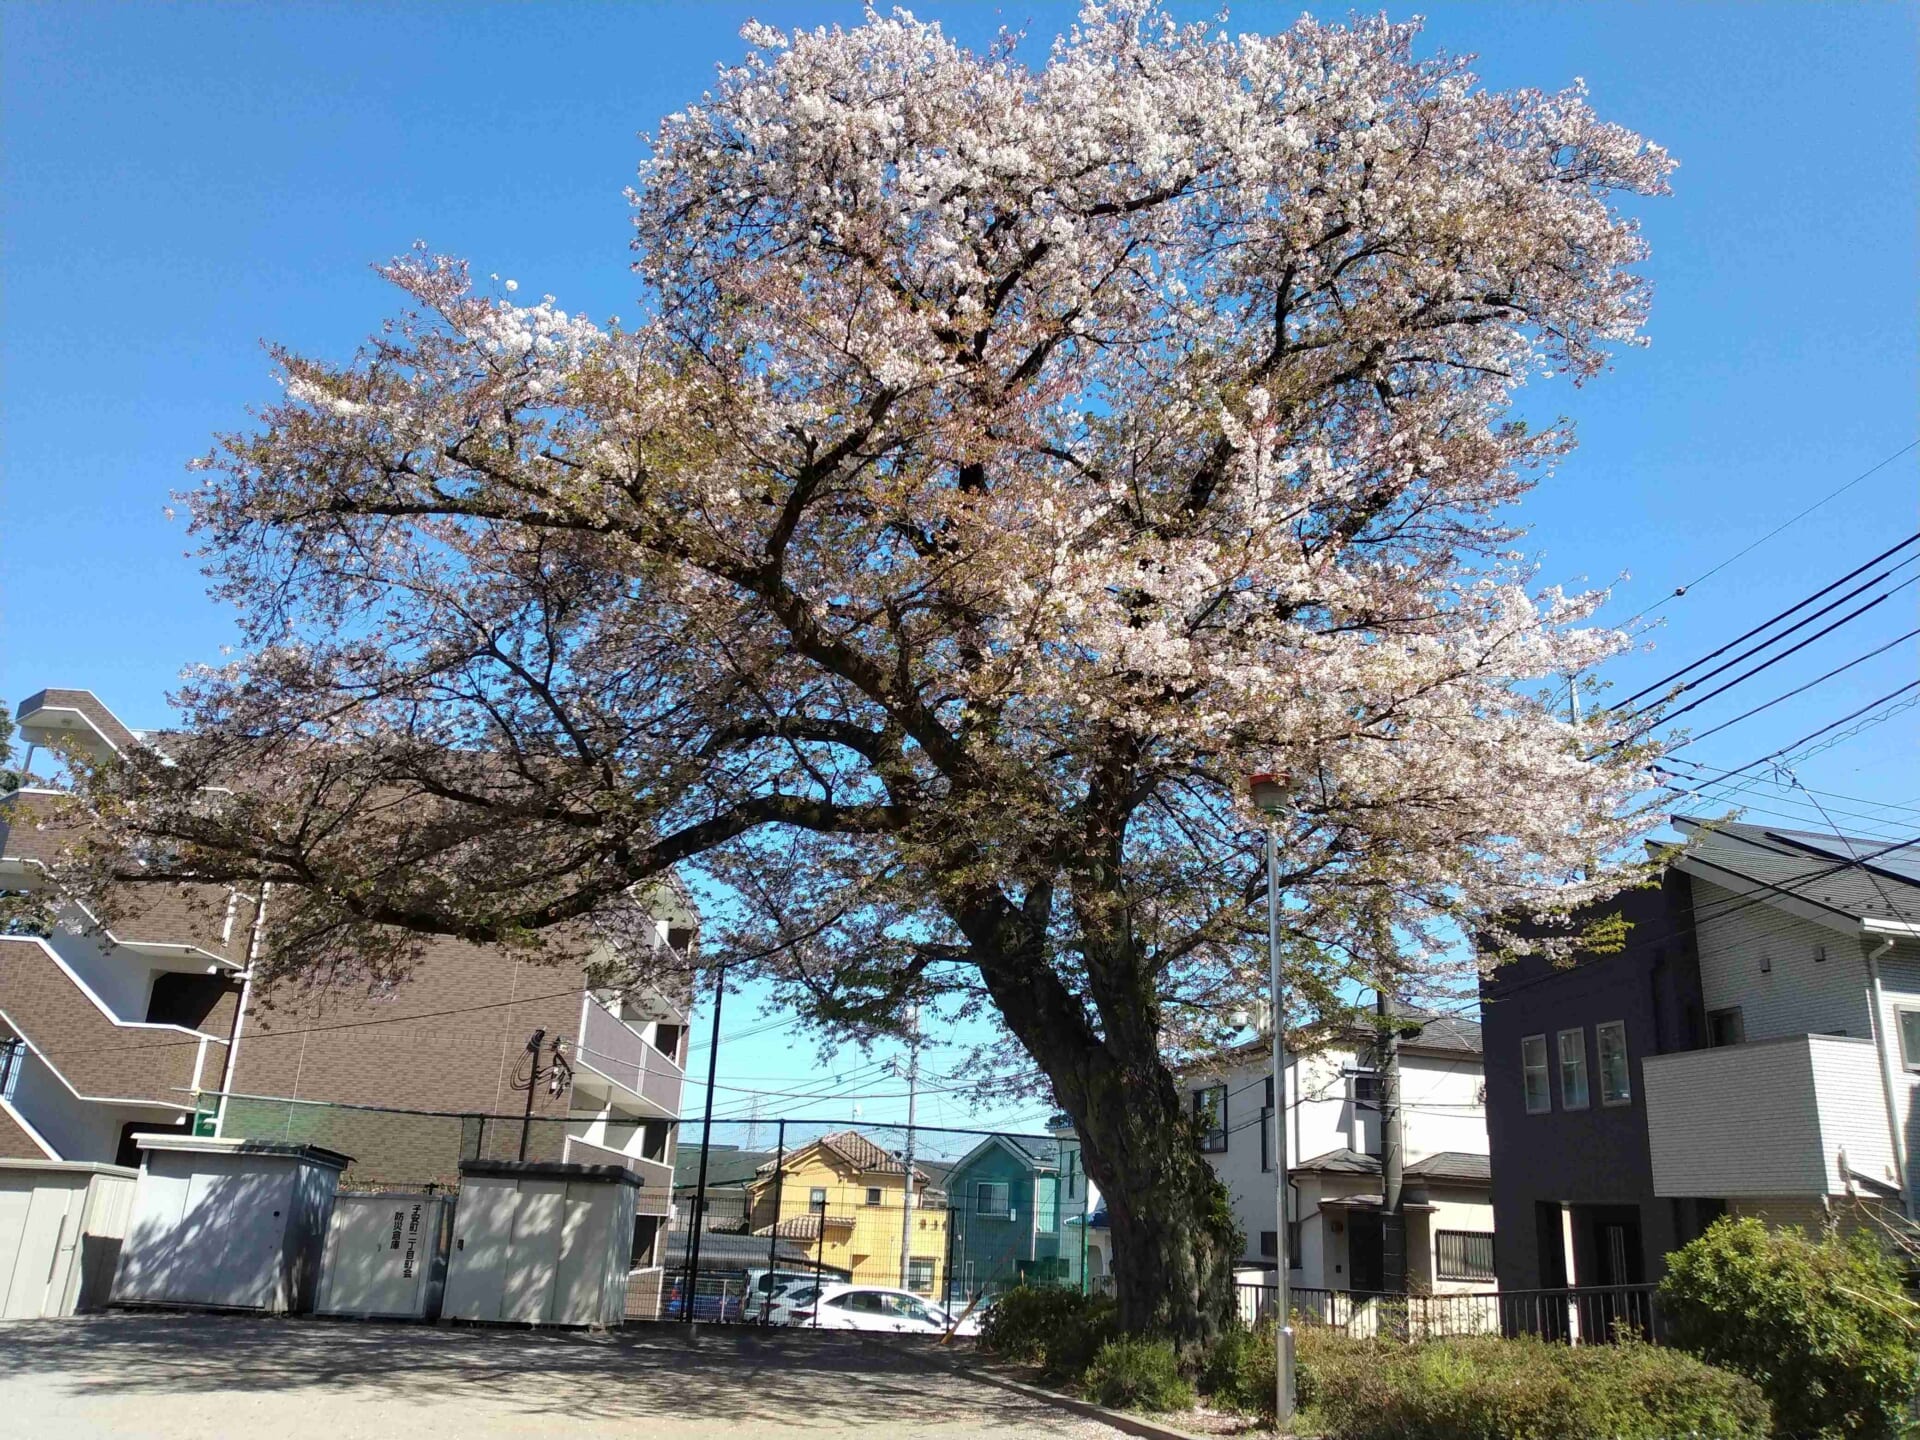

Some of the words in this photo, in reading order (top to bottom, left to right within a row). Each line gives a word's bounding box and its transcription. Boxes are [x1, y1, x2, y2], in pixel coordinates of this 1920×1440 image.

[390, 1212, 404, 1250] 防災倉庫
[403, 1204, 421, 1278] 子安町二丁目町会
